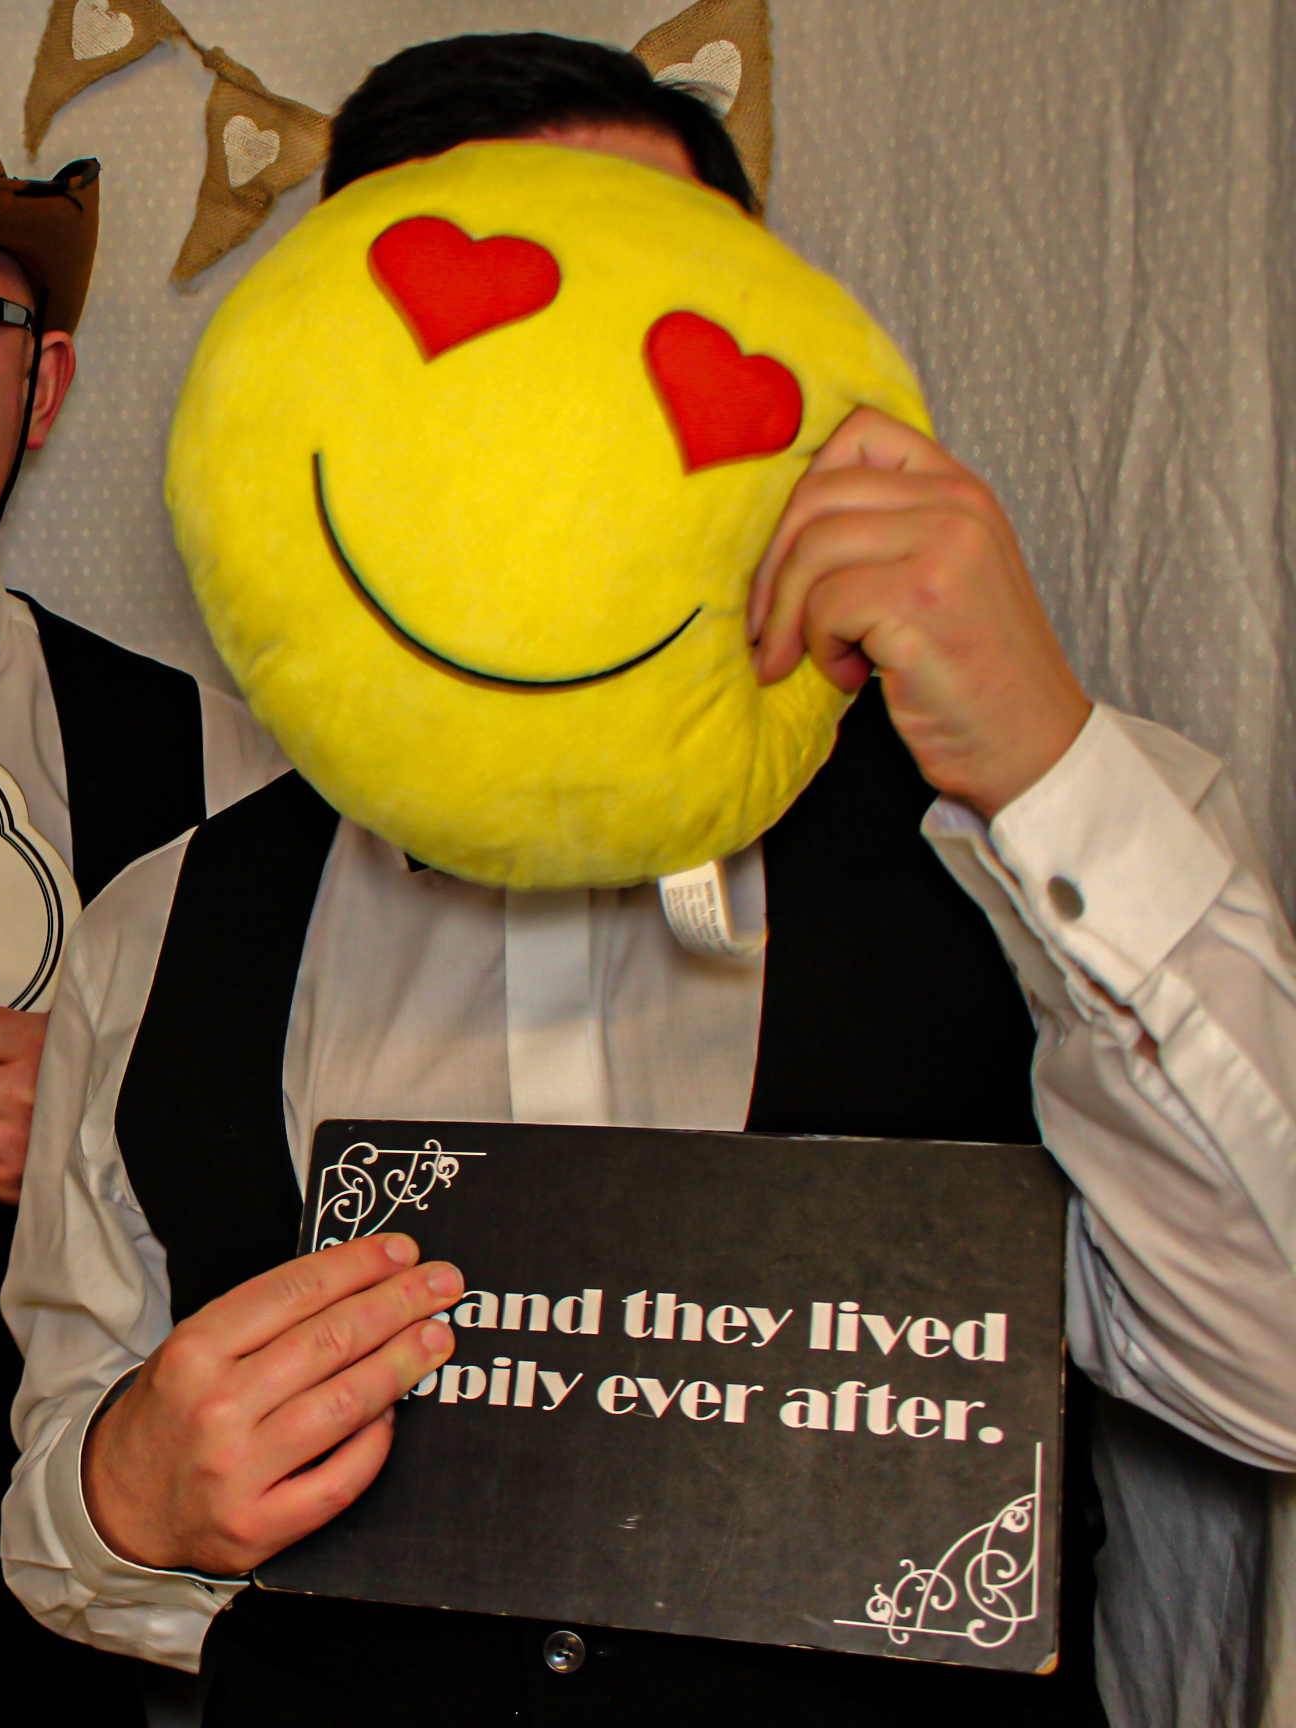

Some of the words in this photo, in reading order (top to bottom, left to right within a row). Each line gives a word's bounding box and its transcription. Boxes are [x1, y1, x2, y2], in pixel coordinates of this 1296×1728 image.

[622, 1289, 794, 1347] they
[810, 1301, 1007, 1362] lived
[597, 1375, 764, 1424] ever
[779, 1380, 1004, 1444] after.
